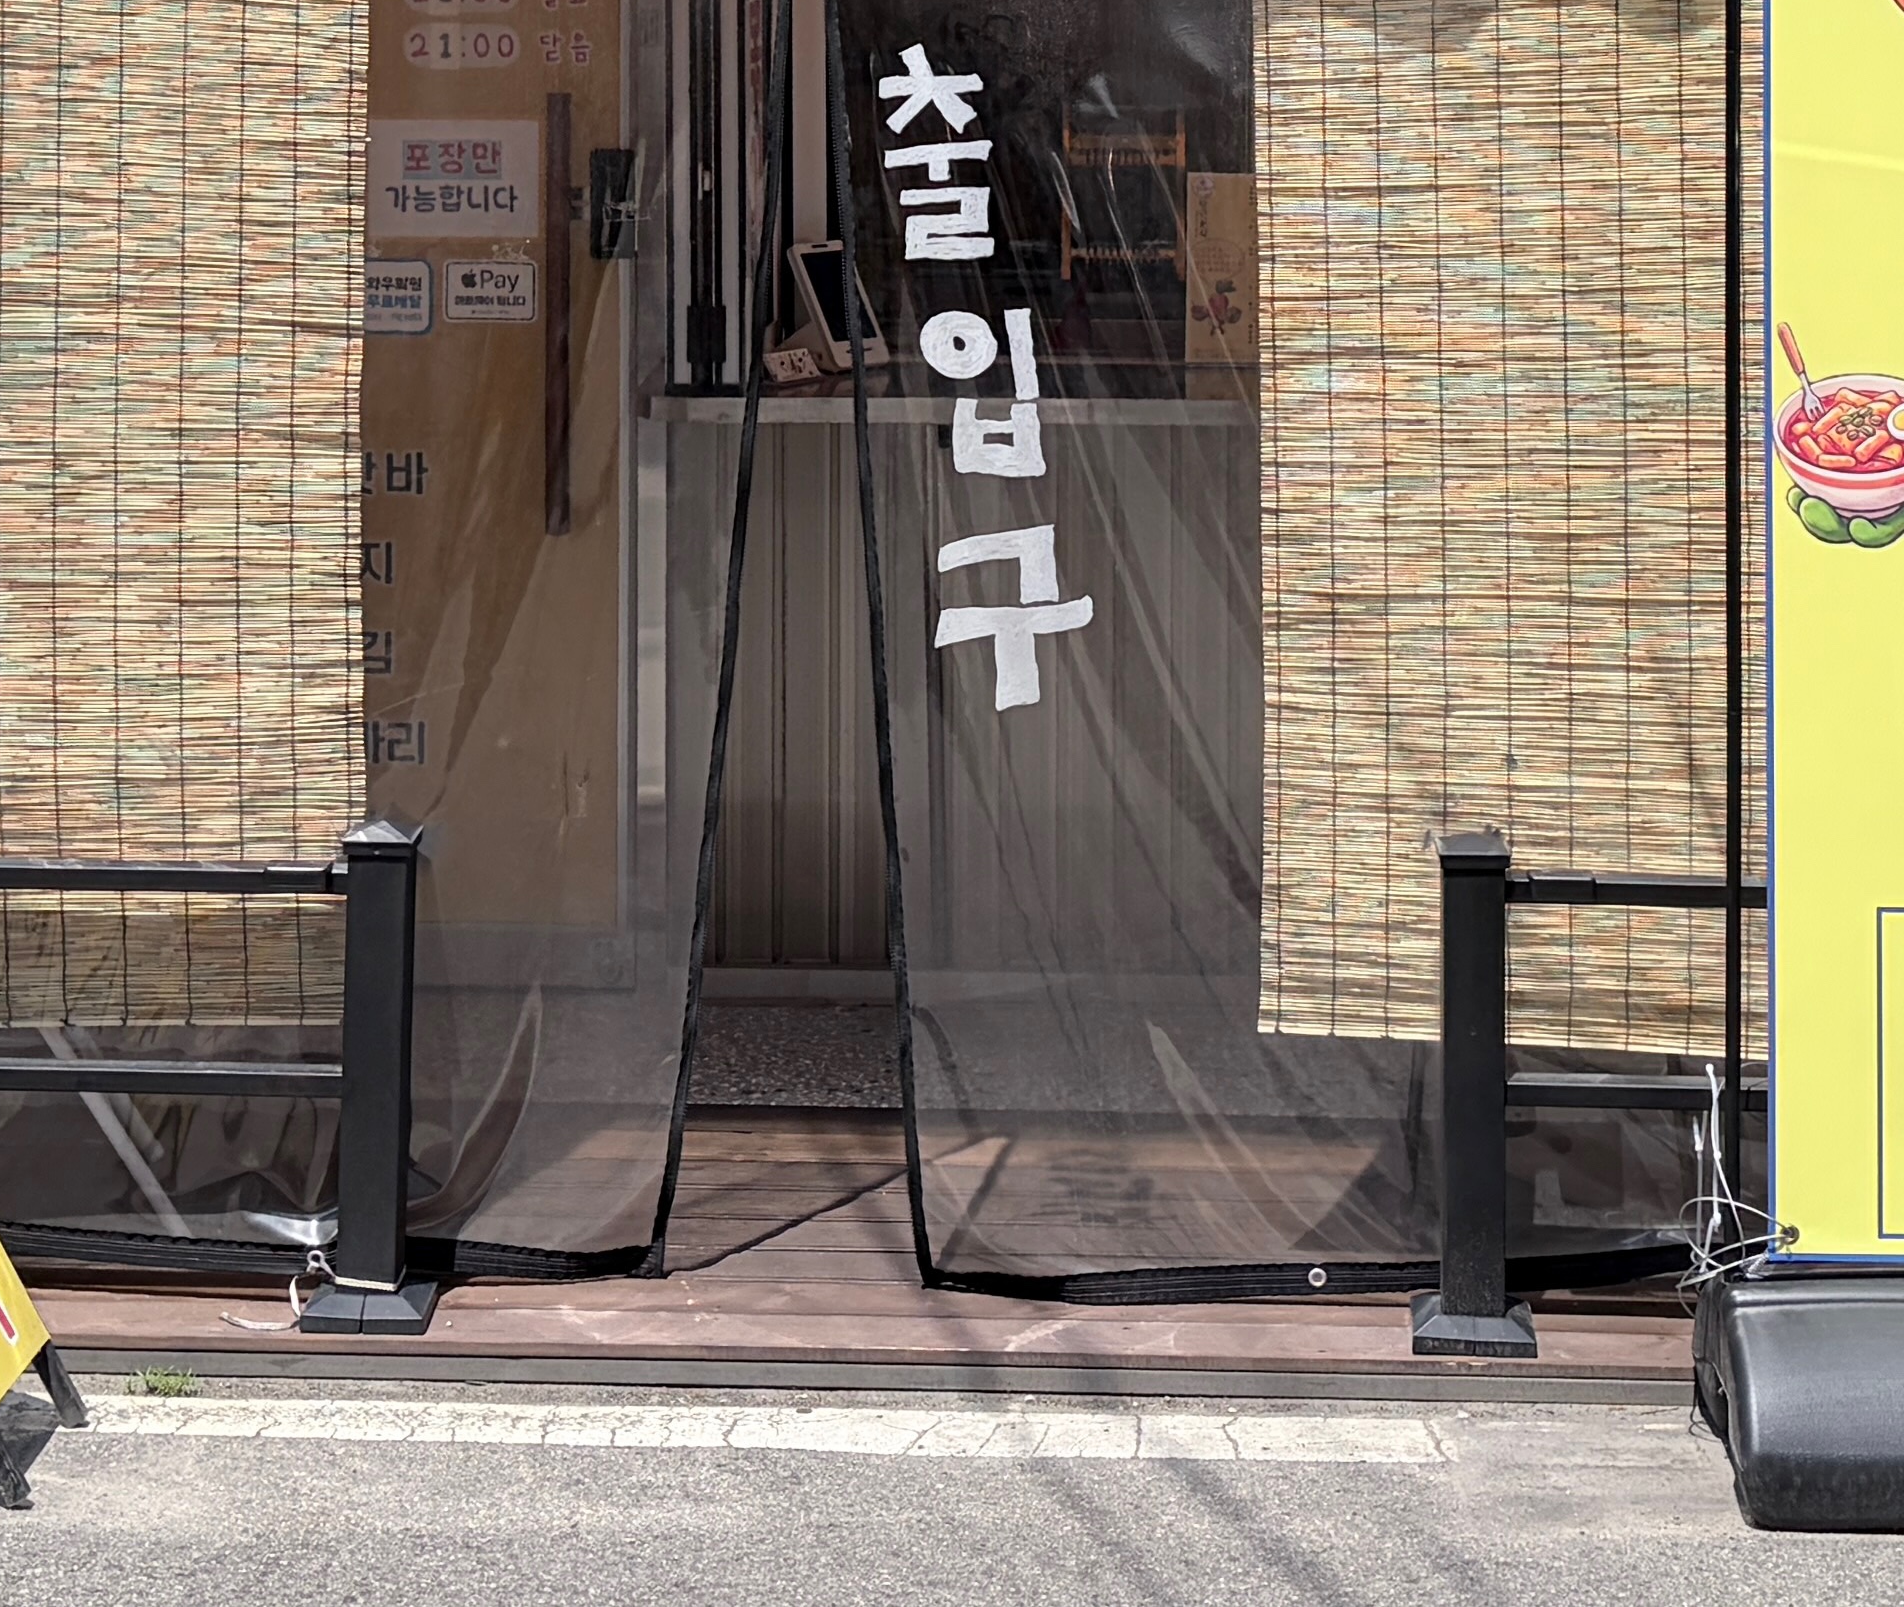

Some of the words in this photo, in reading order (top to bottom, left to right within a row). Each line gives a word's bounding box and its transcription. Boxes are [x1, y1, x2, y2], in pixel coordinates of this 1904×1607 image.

[409, 32, 515, 60] 21:00
[403, 140, 502, 176] 포장만
[385, 184, 519, 214] 가능합니다
[480, 269, 520, 294] Pay
[877, 41, 1095, 713] 출입구
